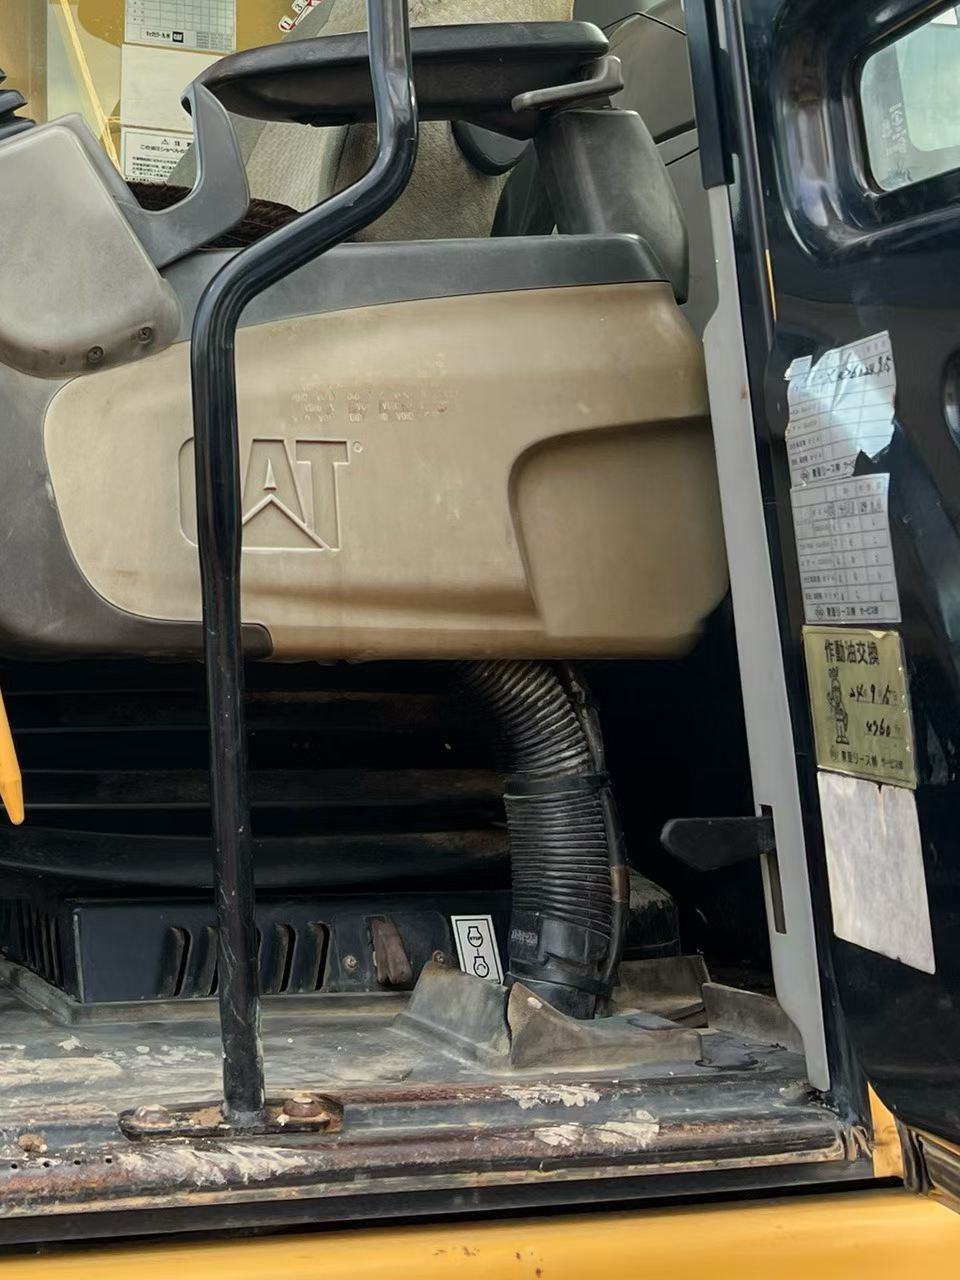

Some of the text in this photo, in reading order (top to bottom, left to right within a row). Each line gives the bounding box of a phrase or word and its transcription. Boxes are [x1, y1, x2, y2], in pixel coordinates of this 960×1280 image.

[824, 638, 880, 665] 作動油交換
